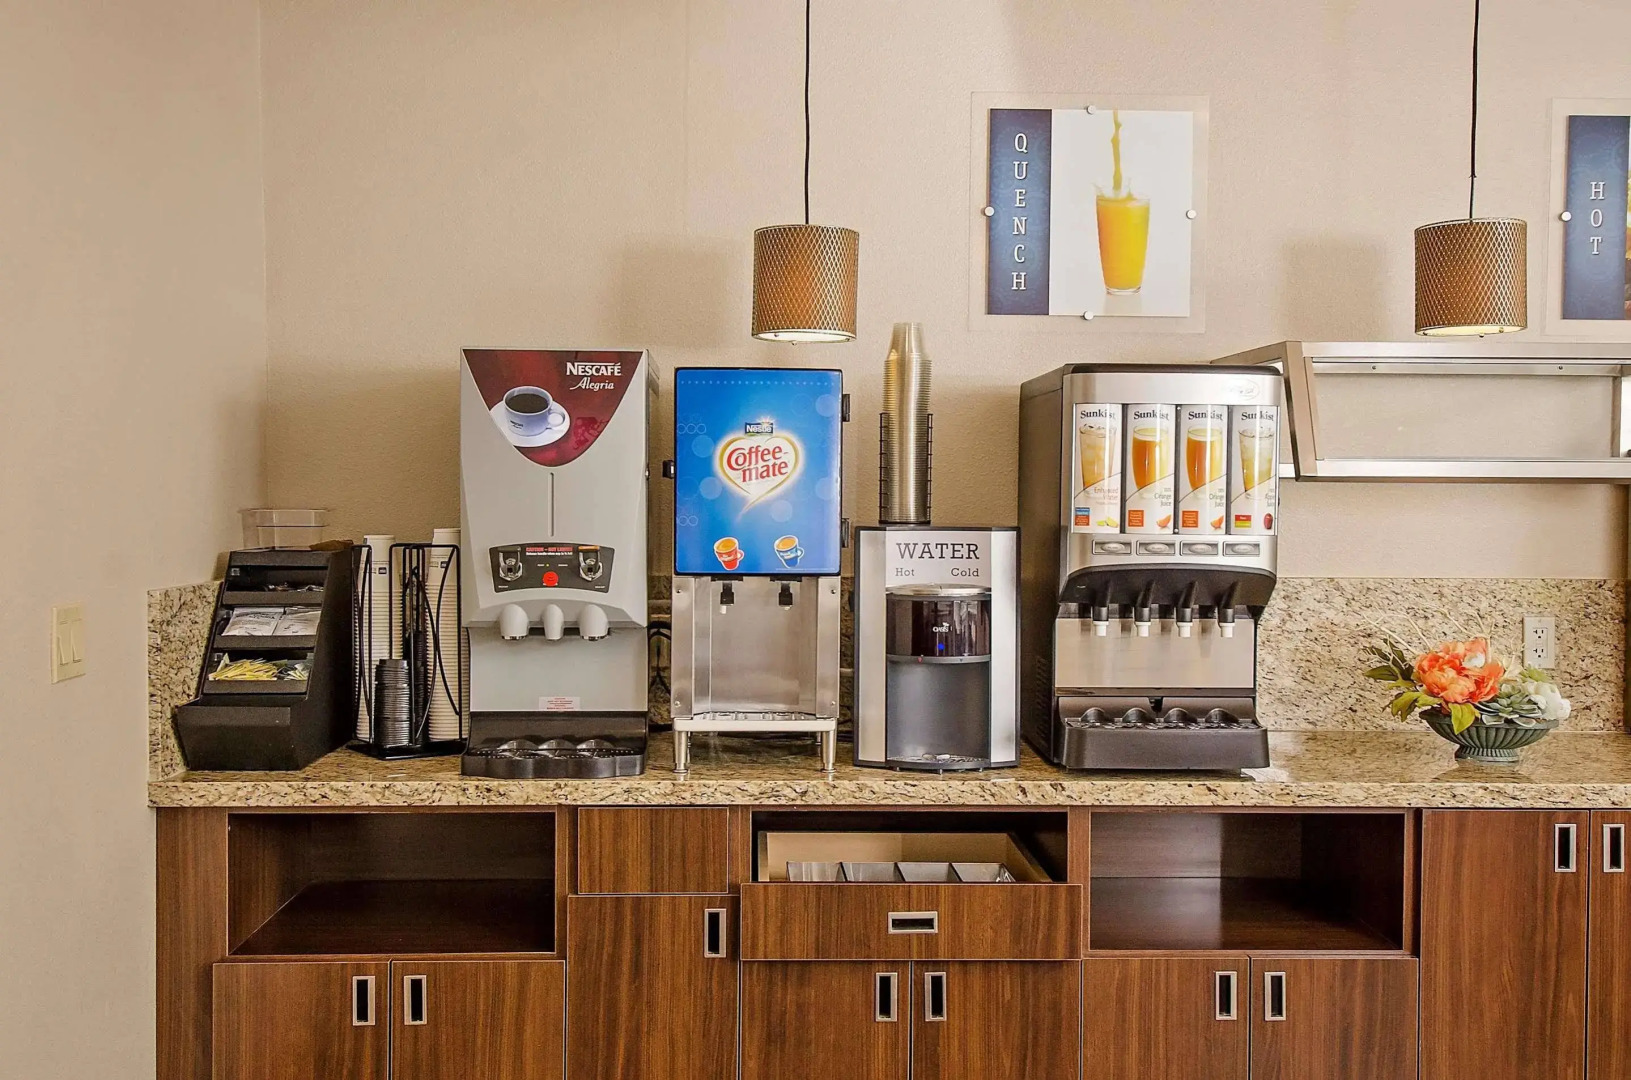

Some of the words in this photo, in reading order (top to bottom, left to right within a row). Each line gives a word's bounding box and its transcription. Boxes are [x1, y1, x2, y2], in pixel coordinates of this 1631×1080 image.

[1011, 132, 1029, 291] QUENCH
[1589, 181, 1606, 255] HOT
[566, 362, 621, 376] NESCAFÉ
[569, 377, 615, 392] Alegria
[1080, 409, 1116, 421] Sunkist
[1133, 410, 1170, 421] Sunkist
[741, 461, 788, 482] mate
[896, 543, 980, 560] WATER
[895, 568, 915, 577] Hot
[951, 568, 980, 577] Cold
